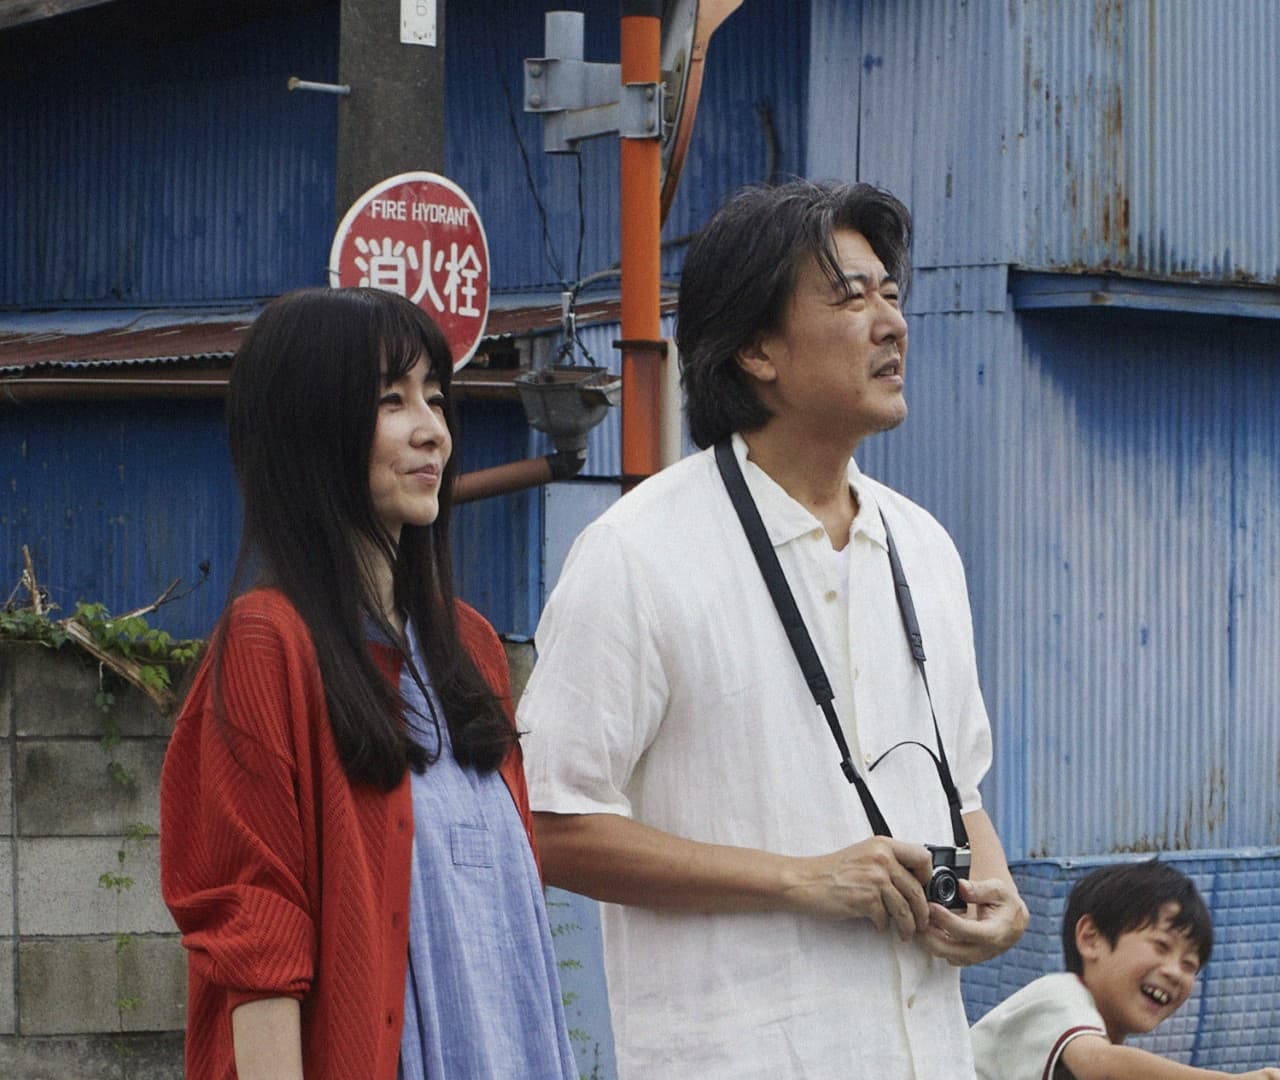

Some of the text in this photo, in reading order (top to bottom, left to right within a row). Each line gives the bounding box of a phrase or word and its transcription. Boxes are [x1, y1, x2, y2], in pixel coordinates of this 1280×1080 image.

[371, 200, 471, 227] FIRE HYDRANT
[354, 237, 482, 317] 消火栓
